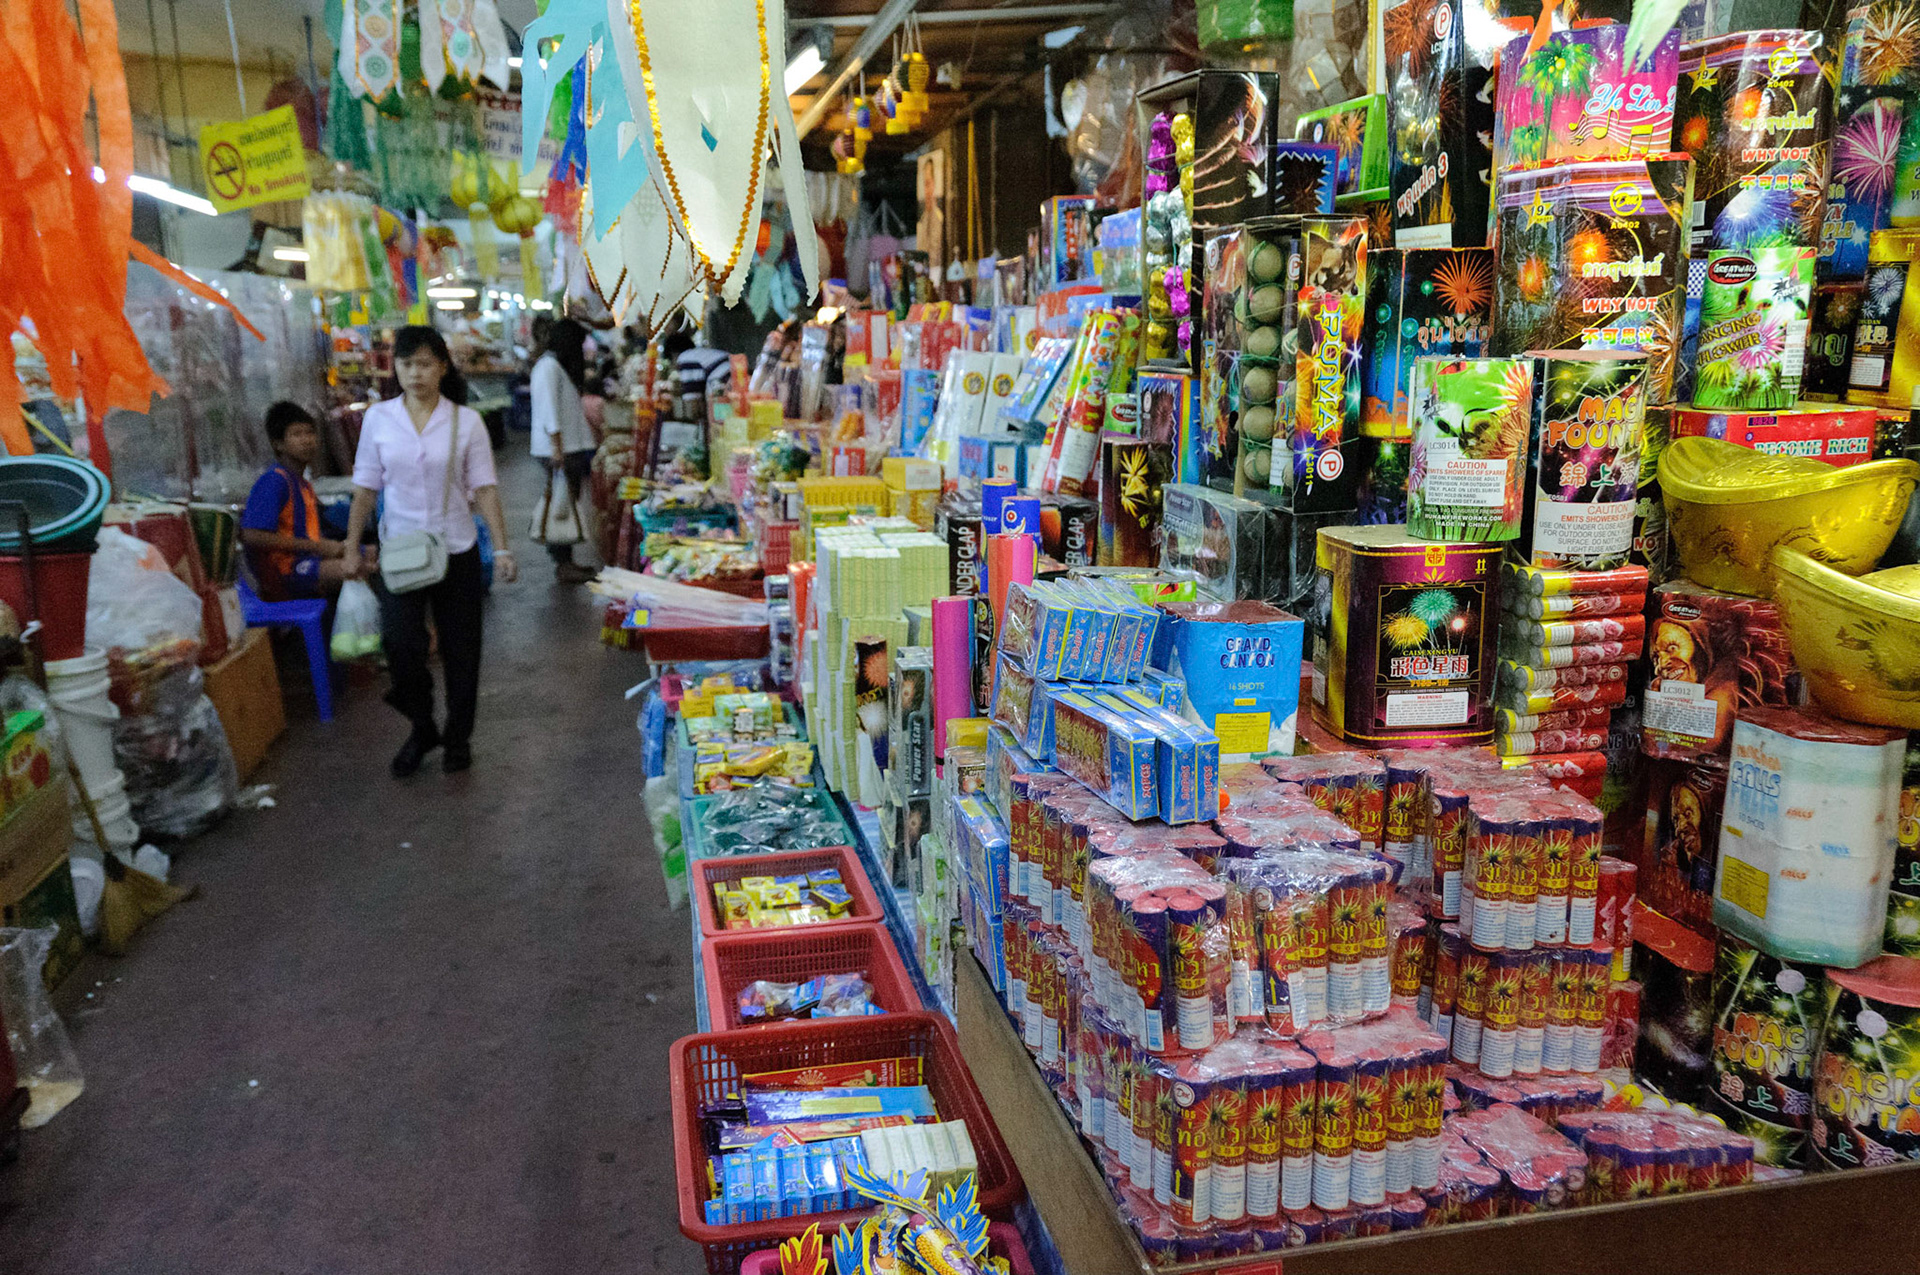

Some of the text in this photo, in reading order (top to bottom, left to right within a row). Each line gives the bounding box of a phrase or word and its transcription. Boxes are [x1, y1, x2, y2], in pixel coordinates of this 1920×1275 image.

[1626, 83, 1662, 112] Lin
[1742, 147, 1811, 162] WHY NOT
[1438, 151, 1449, 178] 3
[1583, 297, 1658, 313] WHY NOT
[1429, 442, 1456, 450] LC3014
[1826, 437, 1870, 455] RICH
[1447, 461, 1488, 470] CAUTION
[1587, 504, 1628, 515] CAUTION
[1553, 522, 1572, 530] ONLY
[1597, 522, 1616, 530] CLOSE
[1561, 515, 1584, 523] EMITS
[1586, 514, 1619, 523] SHOWERS
[1067, 517, 1086, 549] CLAP
[1559, 530, 1592, 538] OUTDOOR
[957, 526, 976, 559] CLAP
[1226, 637, 1272, 653] GRAND
[1219, 652, 1276, 669] CANYON
[1390, 655, 1470, 678] 彩色星雨
[1229, 681, 1265, 691] 16 SHOTS
[1663, 685, 1691, 696] LC3012
[911, 721, 922, 782] Power Star
[1731, 760, 1782, 799] FALLS
